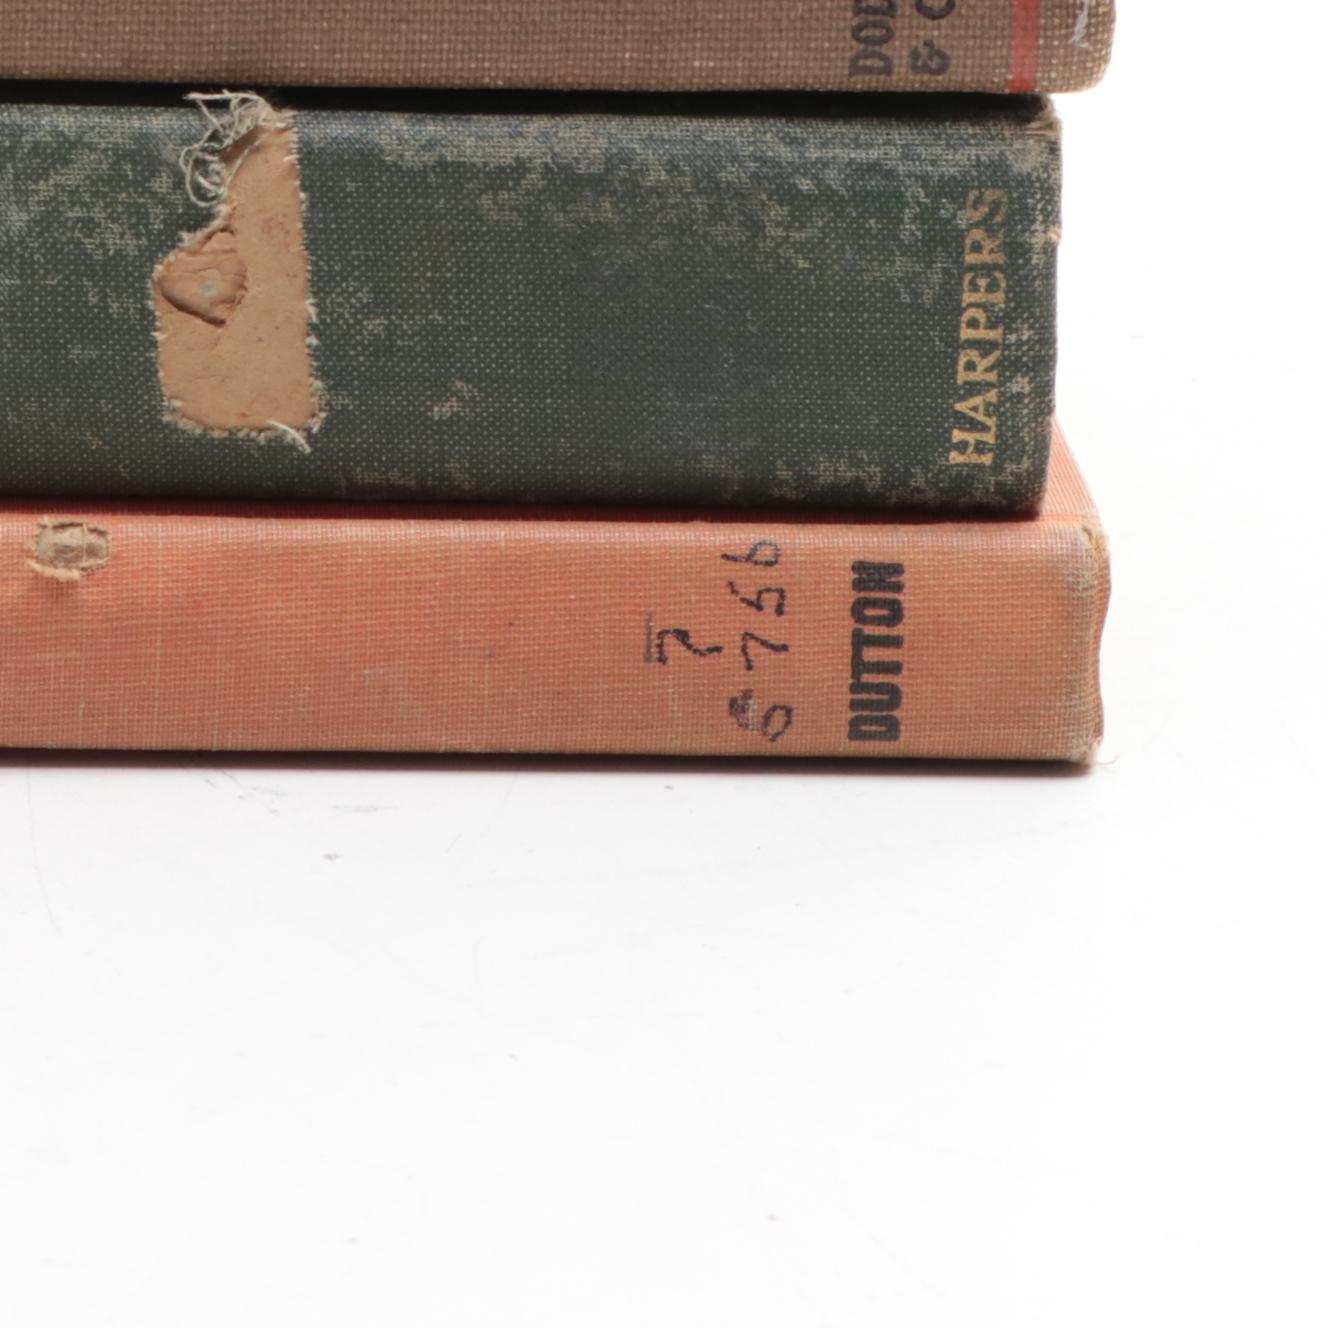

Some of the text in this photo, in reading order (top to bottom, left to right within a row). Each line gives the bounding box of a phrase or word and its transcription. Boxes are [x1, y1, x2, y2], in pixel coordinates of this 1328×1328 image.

[908, 37, 951, 75] &
[948, 187, 1009, 468] HARPERS
[847, 560, 906, 742] DUTTON
